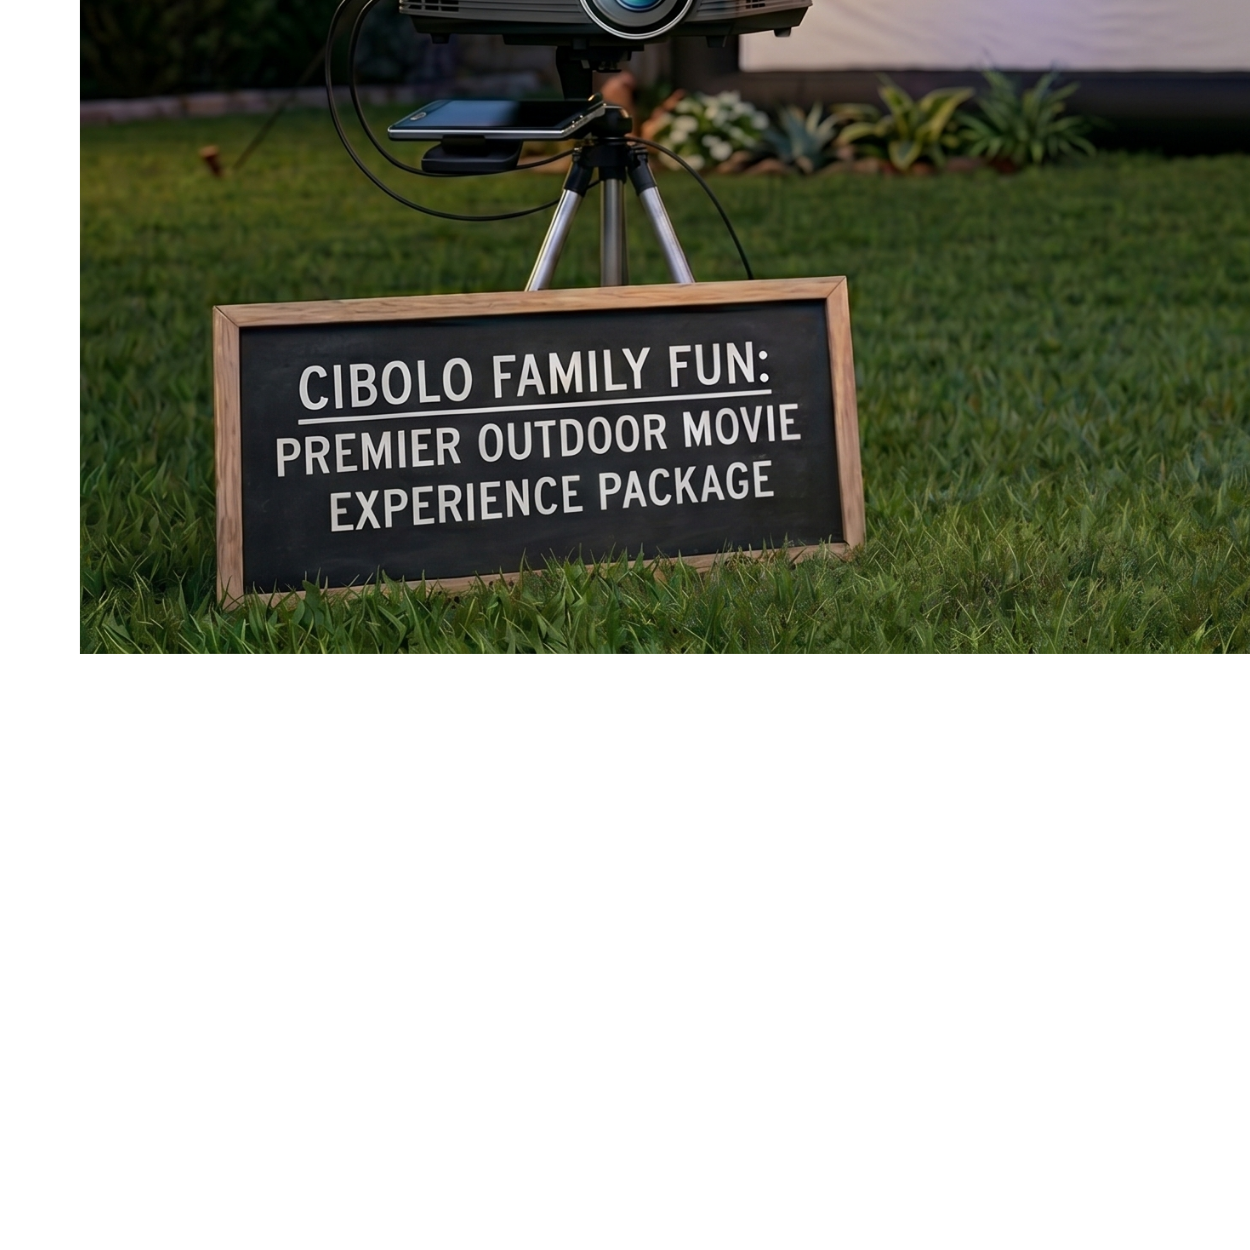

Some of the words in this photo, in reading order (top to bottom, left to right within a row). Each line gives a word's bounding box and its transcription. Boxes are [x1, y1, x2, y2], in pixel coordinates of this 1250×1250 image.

[299, 357, 473, 410] CIBOLO
[493, 347, 651, 399] FAMILY
[669, 341, 771, 387] FUN:
[275, 426, 461, 477] PREMIER
[478, 414, 668, 462] OUTDOOR
[683, 403, 801, 448] MOVIE
[329, 474, 584, 532] EXPERIENCE
[598, 459, 775, 511] PACKAGE
